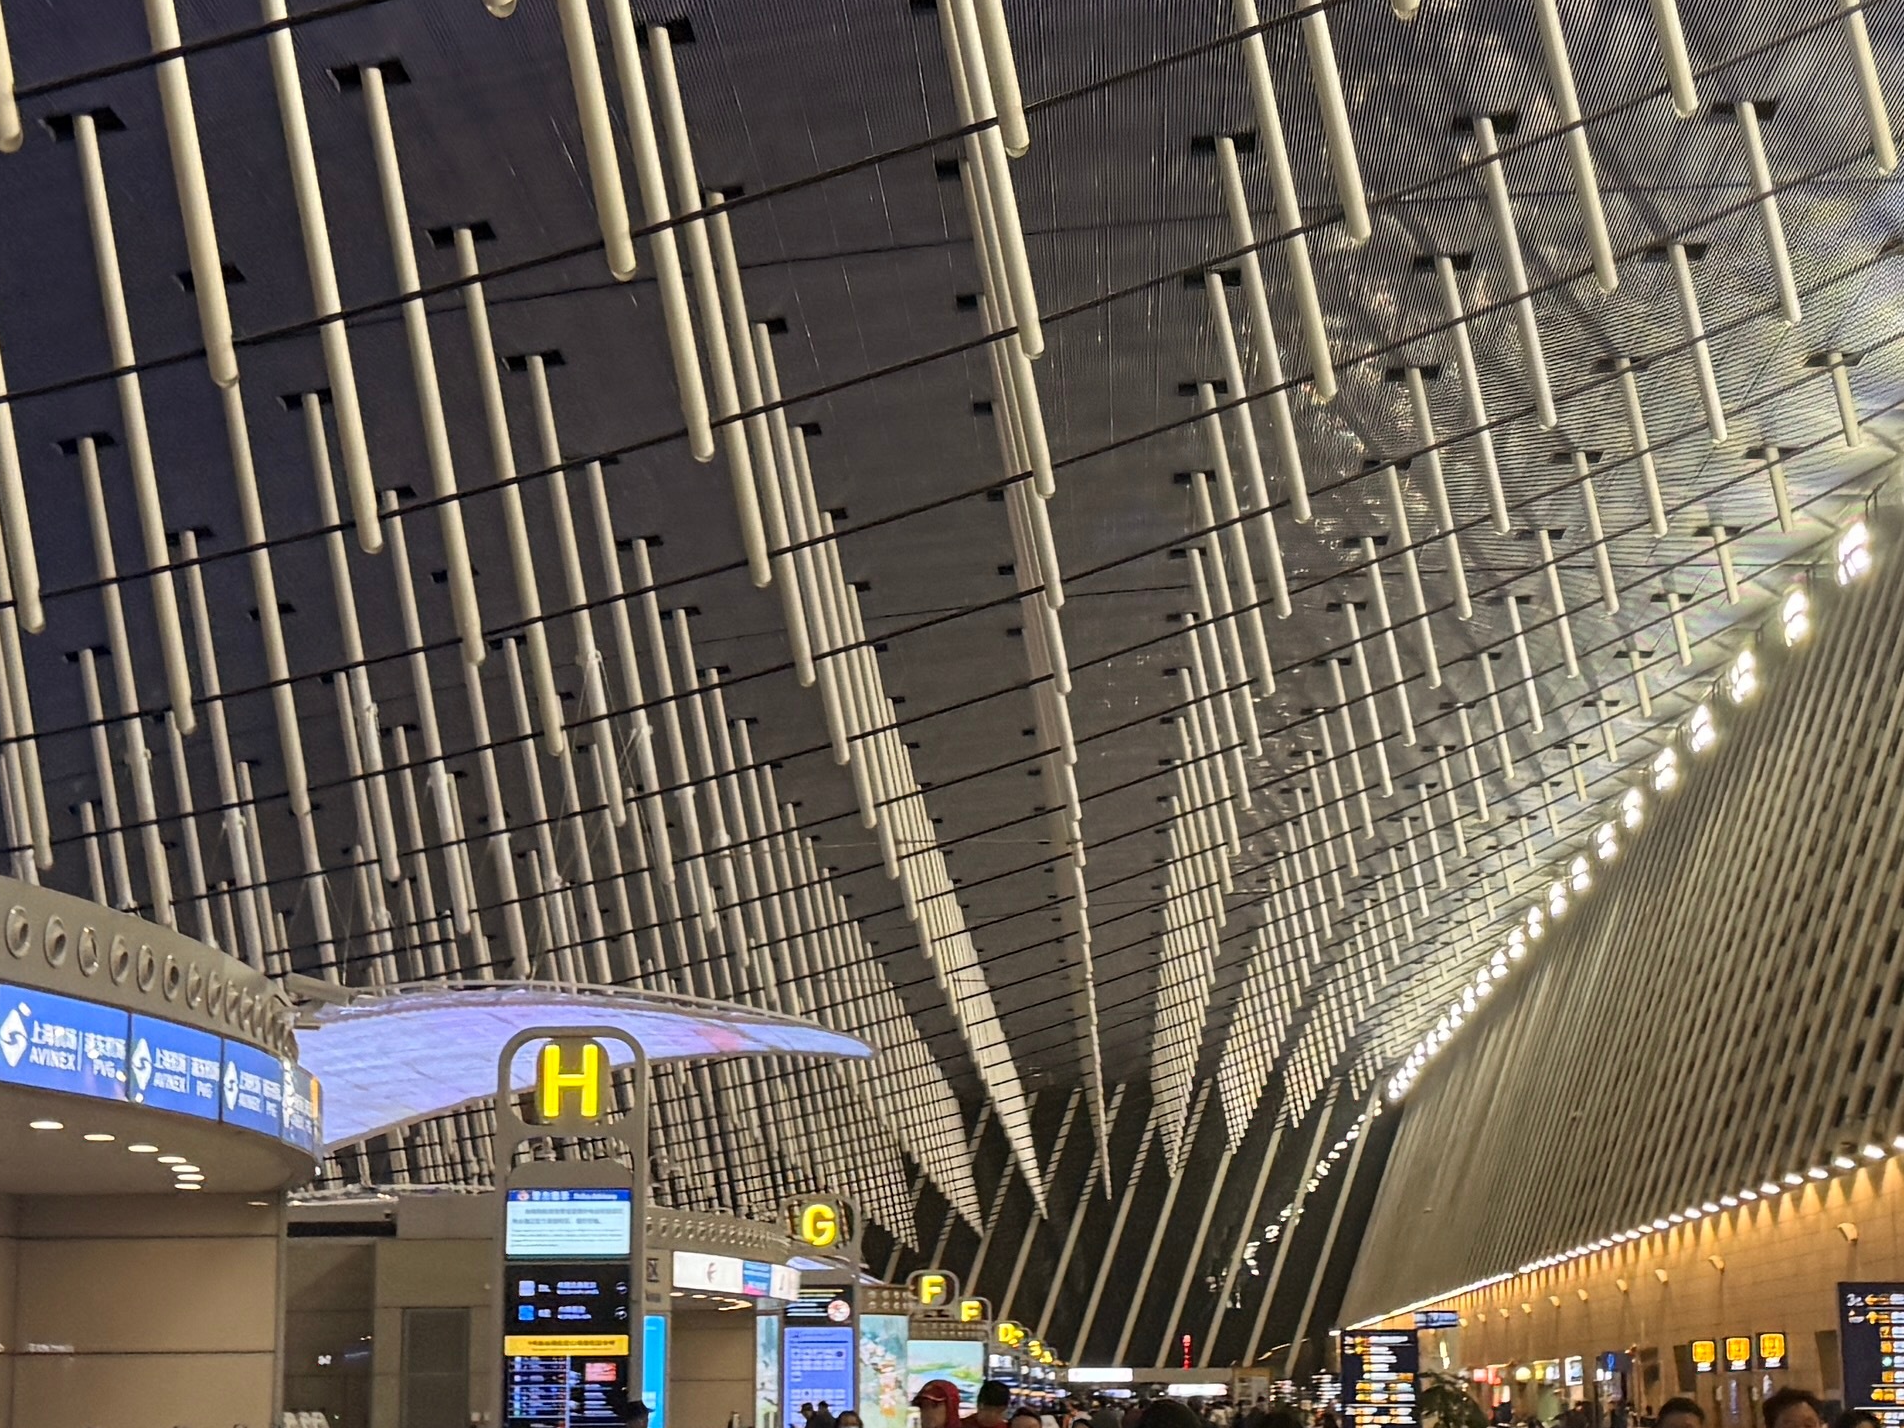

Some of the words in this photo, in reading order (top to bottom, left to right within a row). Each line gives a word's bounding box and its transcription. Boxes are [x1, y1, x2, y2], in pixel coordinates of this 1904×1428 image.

[543, 1042, 599, 1119] H
[802, 1204, 837, 1247] G
[921, 1275, 945, 1304] F
